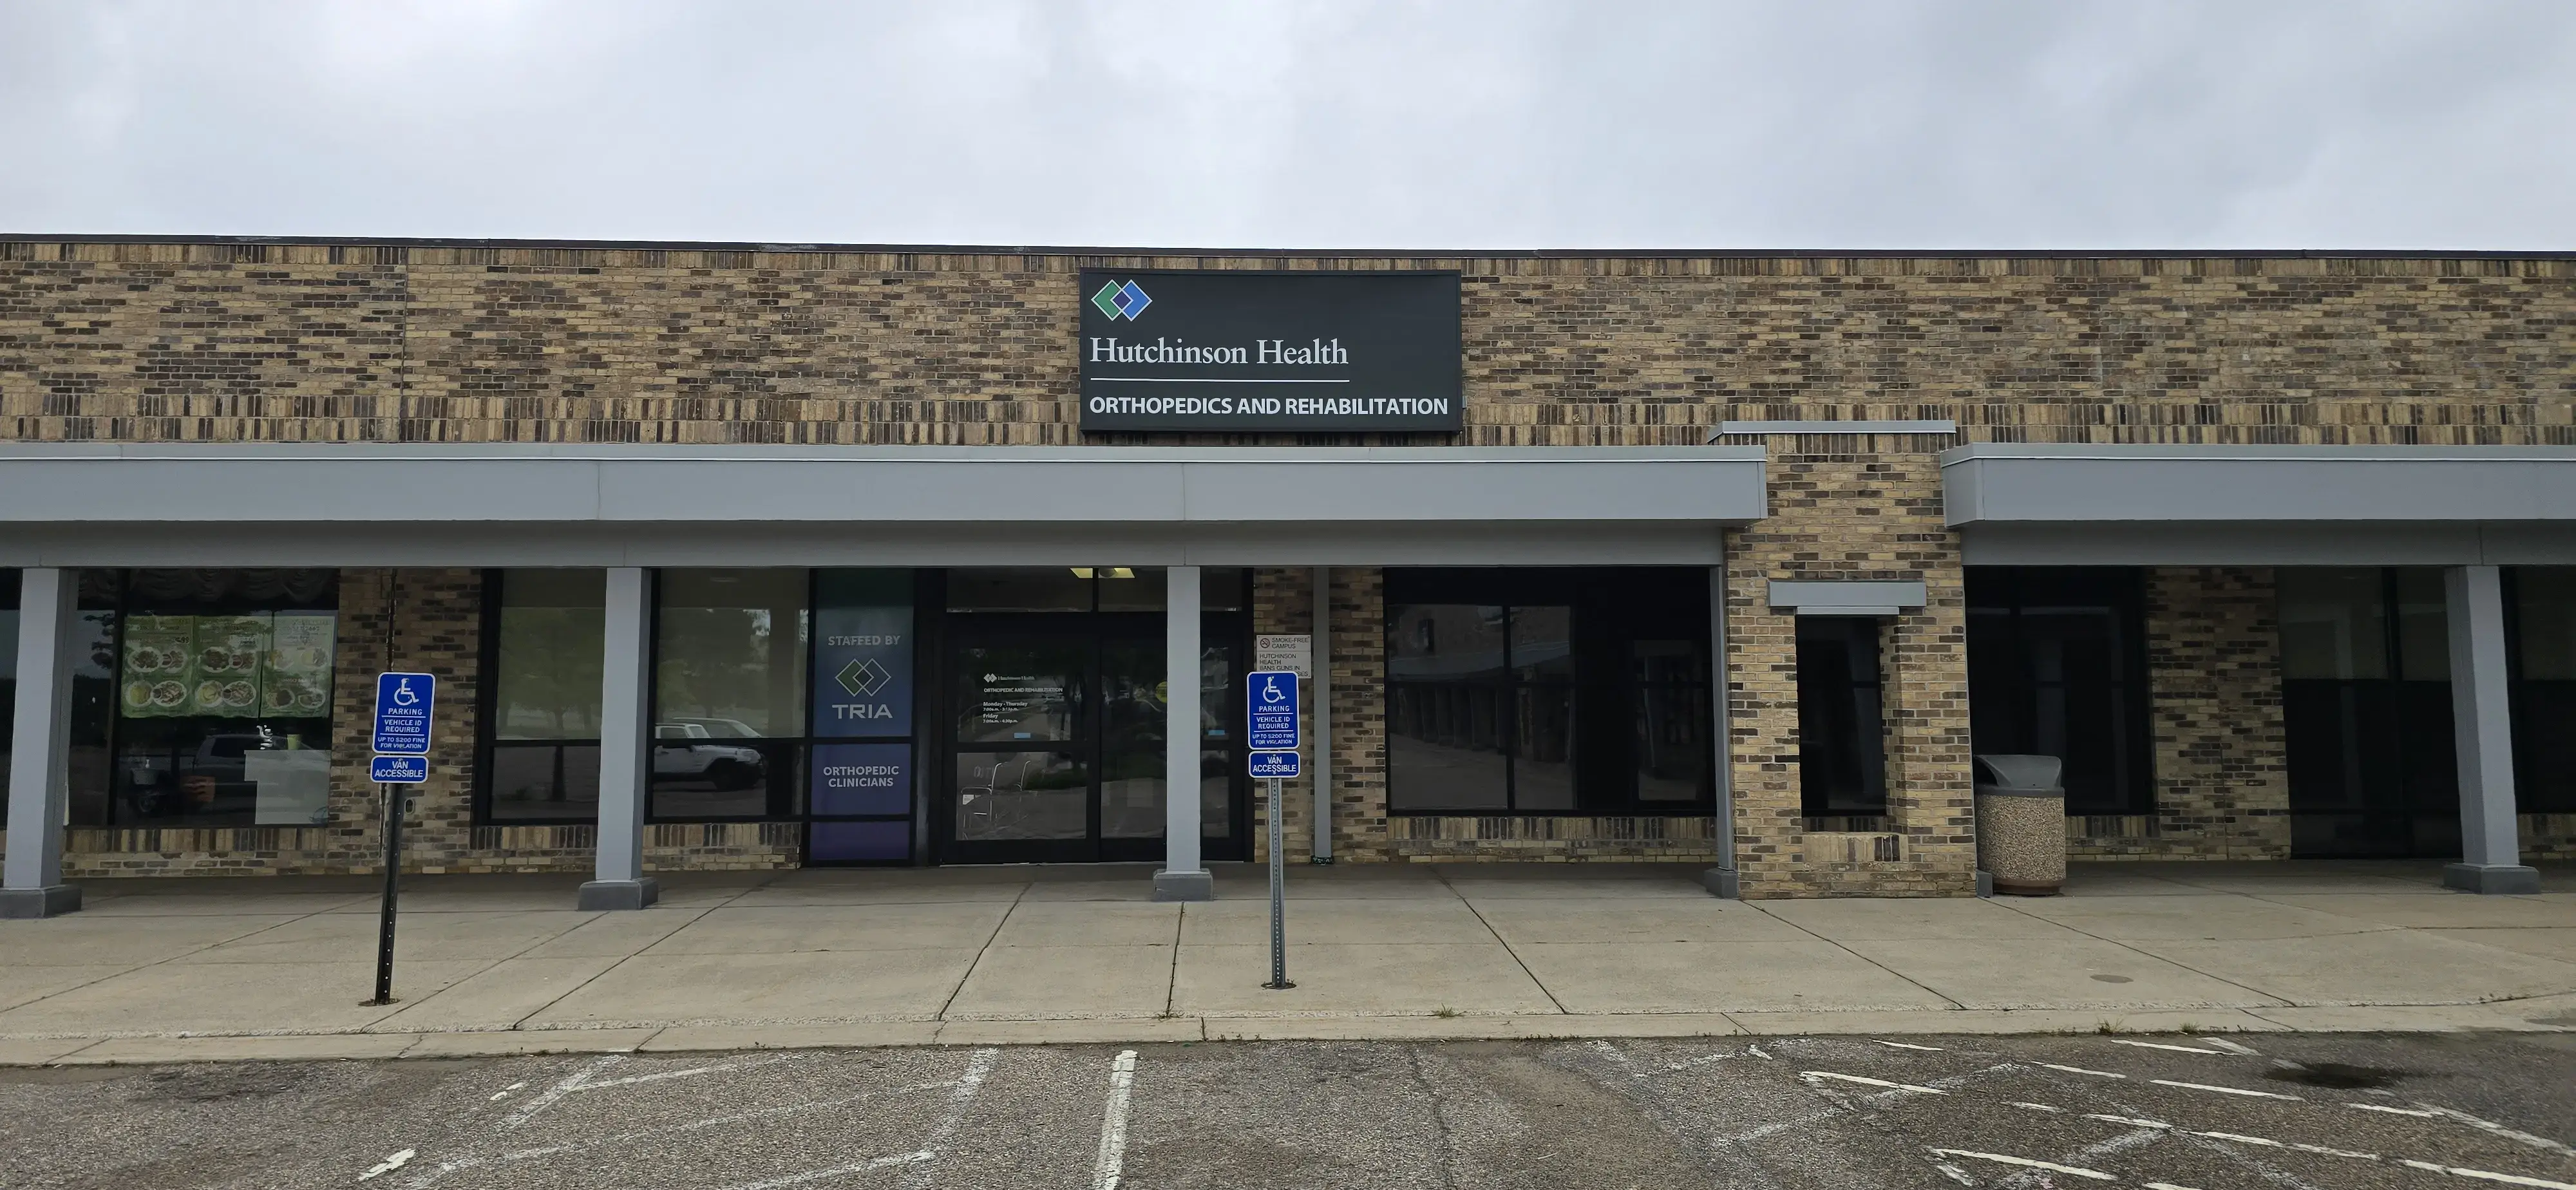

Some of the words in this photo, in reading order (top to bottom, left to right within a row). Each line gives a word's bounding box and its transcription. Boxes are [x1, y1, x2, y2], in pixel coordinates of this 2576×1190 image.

[1090, 337, 1248, 364] Hutchinson
[1256, 339, 1349, 365] Health
[1090, 397, 1233, 415] ORTHOPEDICS
[1236, 398, 1282, 415] AND
[1285, 397, 1448, 415] REHABILITATION
[828, 636, 881, 646] STAFFED
[885, 635, 901, 645] BY
[831, 704, 893, 719] TRIA
[392, 760, 409, 770] VAN
[1267, 756, 1282, 764] VAN
[374, 769, 424, 778] ACCESSIBLE
[823, 766, 899, 776] ORTHOPEDIC
[1252, 764, 1297, 773] ACCESSIBLE
[828, 777, 894, 788] CLINICIANS
